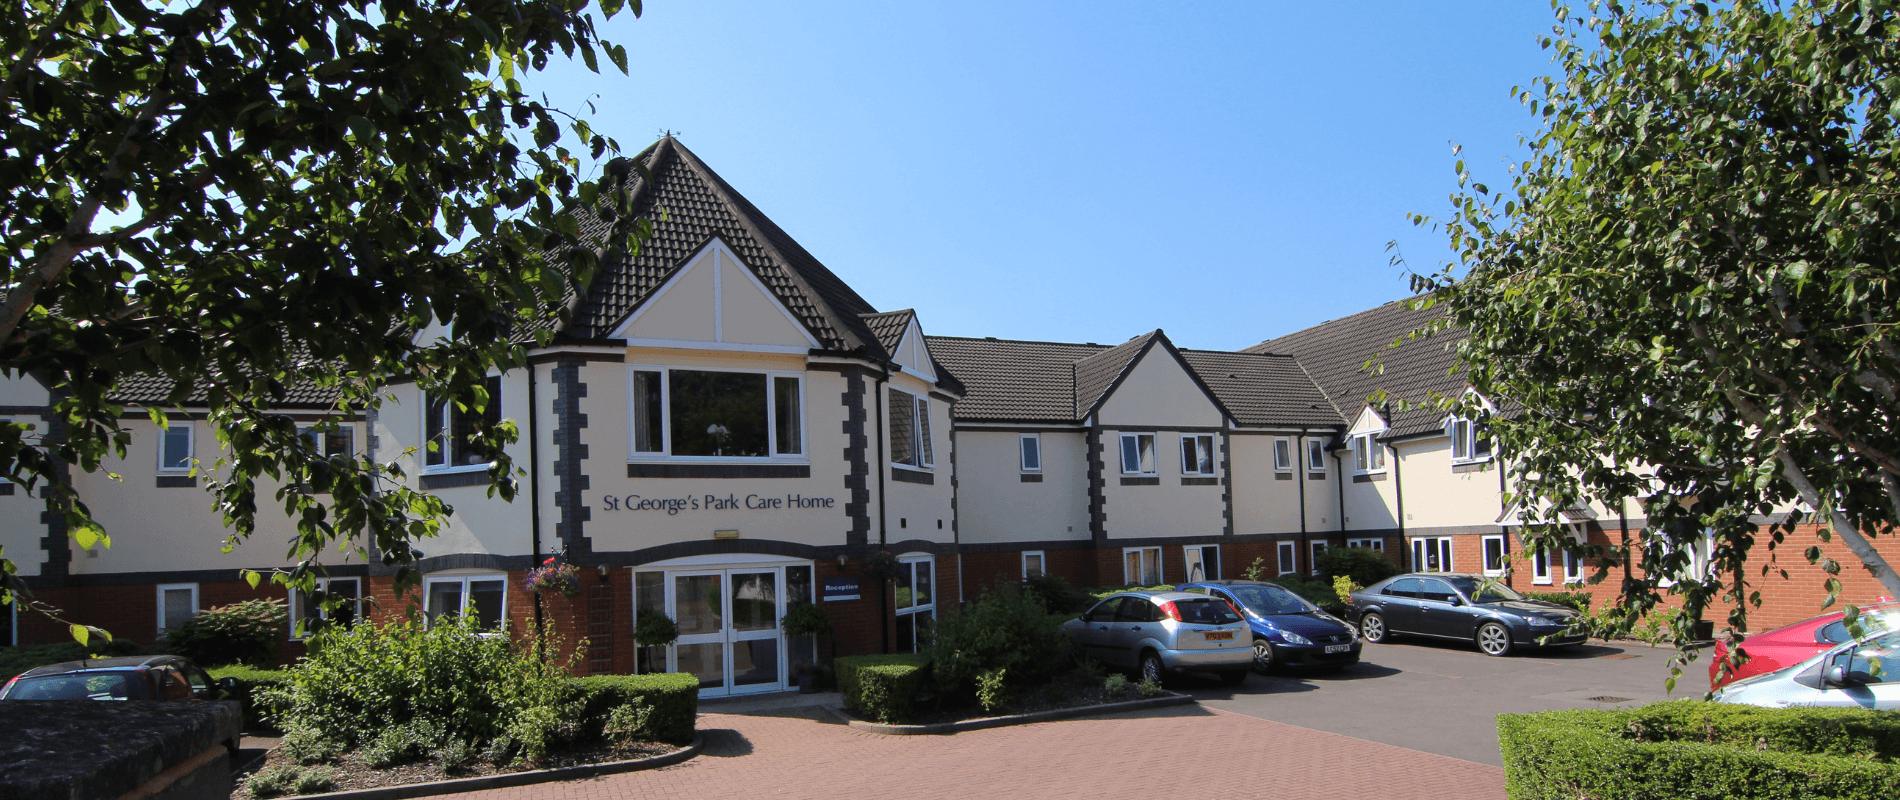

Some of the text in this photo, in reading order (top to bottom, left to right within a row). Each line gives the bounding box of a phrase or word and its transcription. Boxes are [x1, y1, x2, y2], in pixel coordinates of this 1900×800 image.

[603, 493, 834, 516] St George’s Park Care Home
